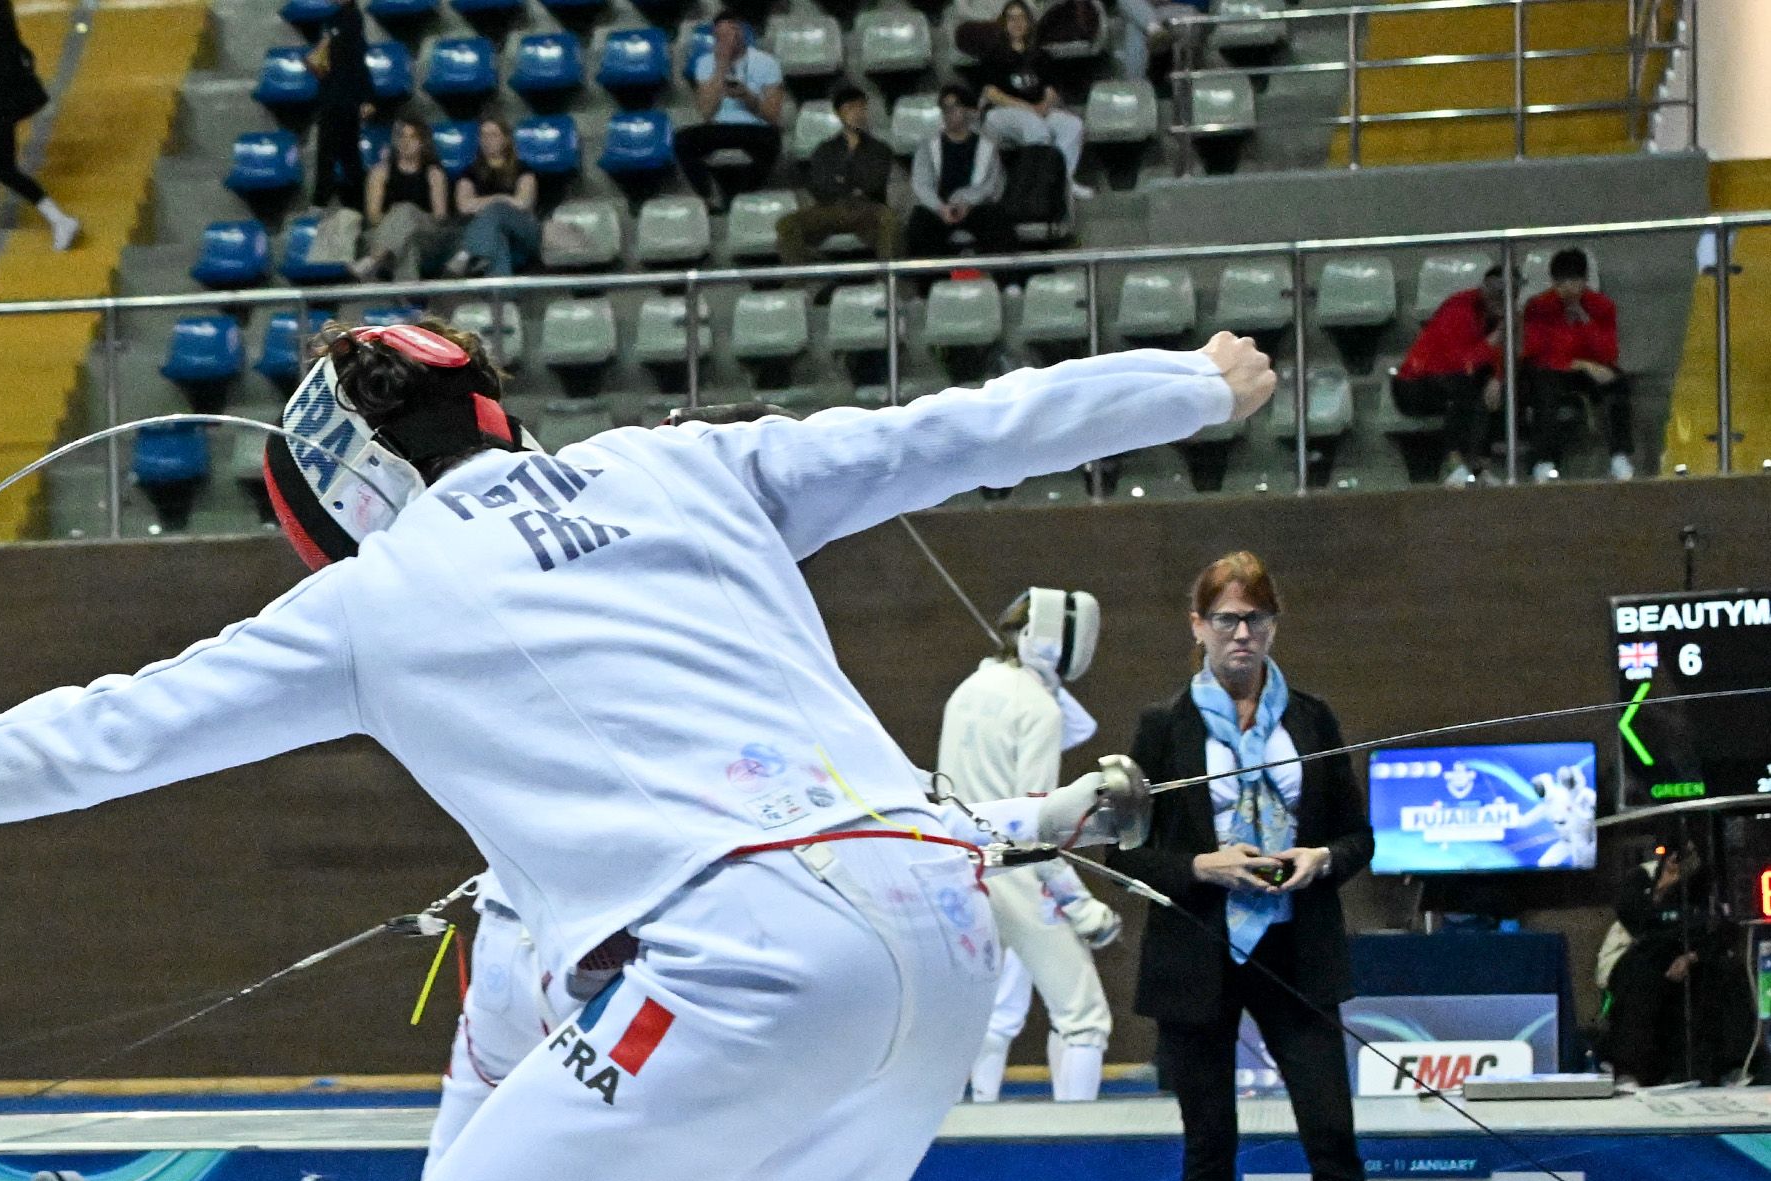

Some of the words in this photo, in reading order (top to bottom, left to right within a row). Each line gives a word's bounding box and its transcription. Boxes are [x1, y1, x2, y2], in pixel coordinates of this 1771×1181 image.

[1615, 597, 1771, 634] BEAUTYM
[1678, 642, 1703, 677] 6
[548, 1024, 620, 1106] FRA
[1409, 1159, 1478, 1172] JANUARY
